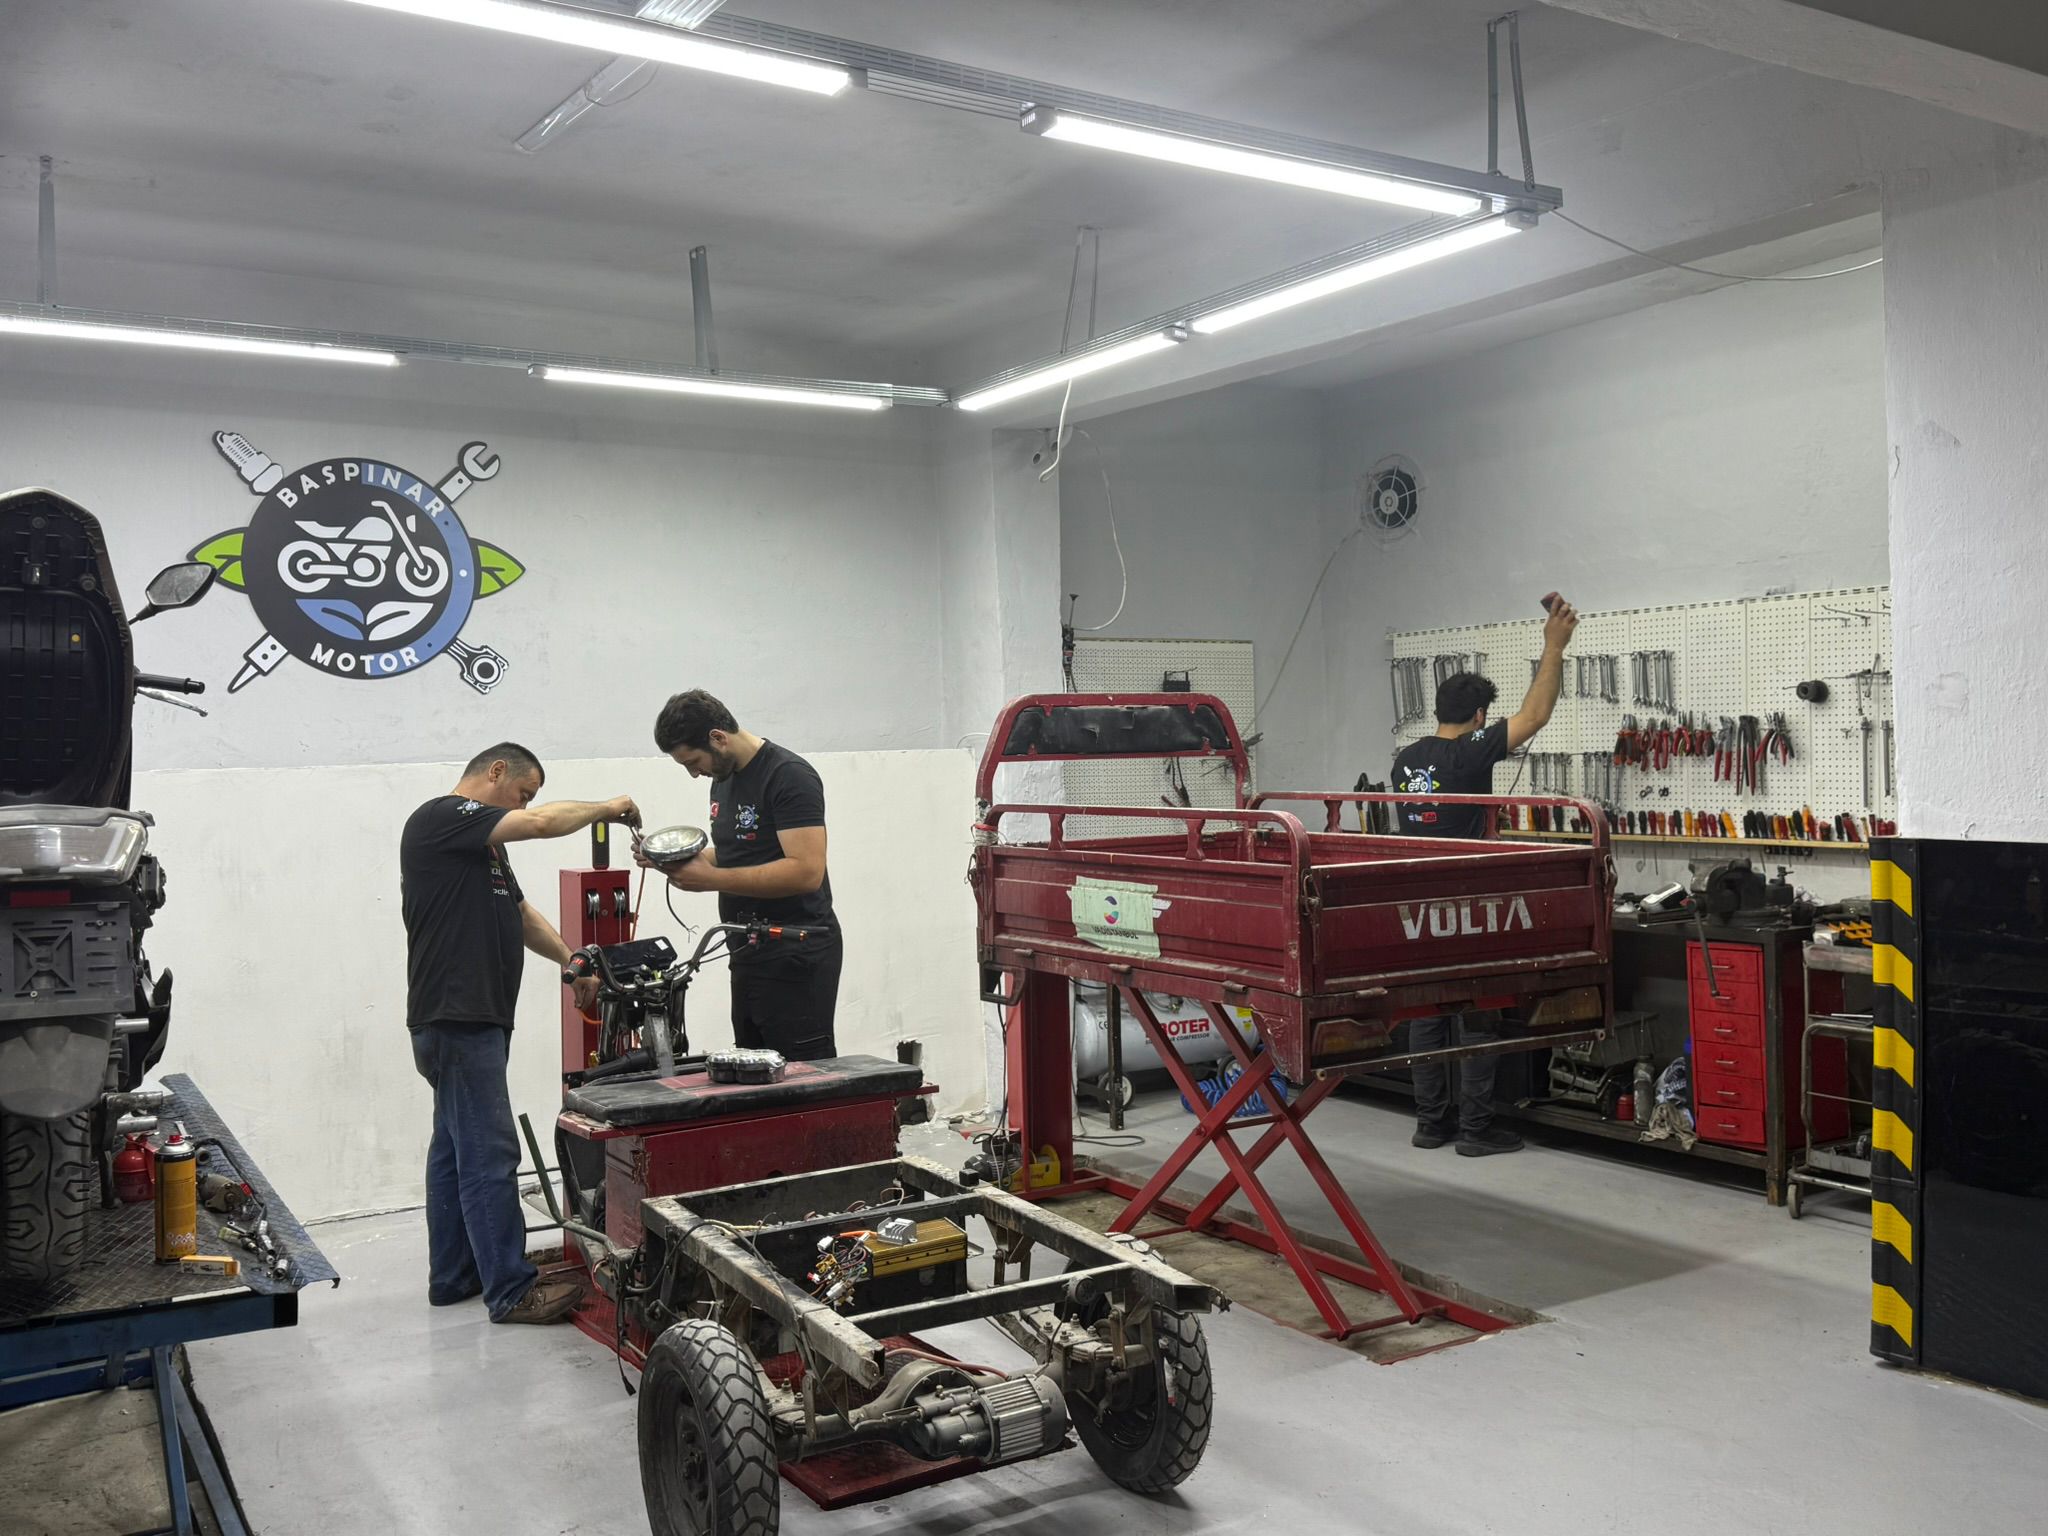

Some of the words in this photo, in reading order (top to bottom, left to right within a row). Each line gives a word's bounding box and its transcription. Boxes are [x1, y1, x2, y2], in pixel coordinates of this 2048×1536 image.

[276, 462, 445, 517] BAŞPINAR
[310, 643, 420, 674] MOTOR
[1396, 896, 1534, 940] VOLTA
